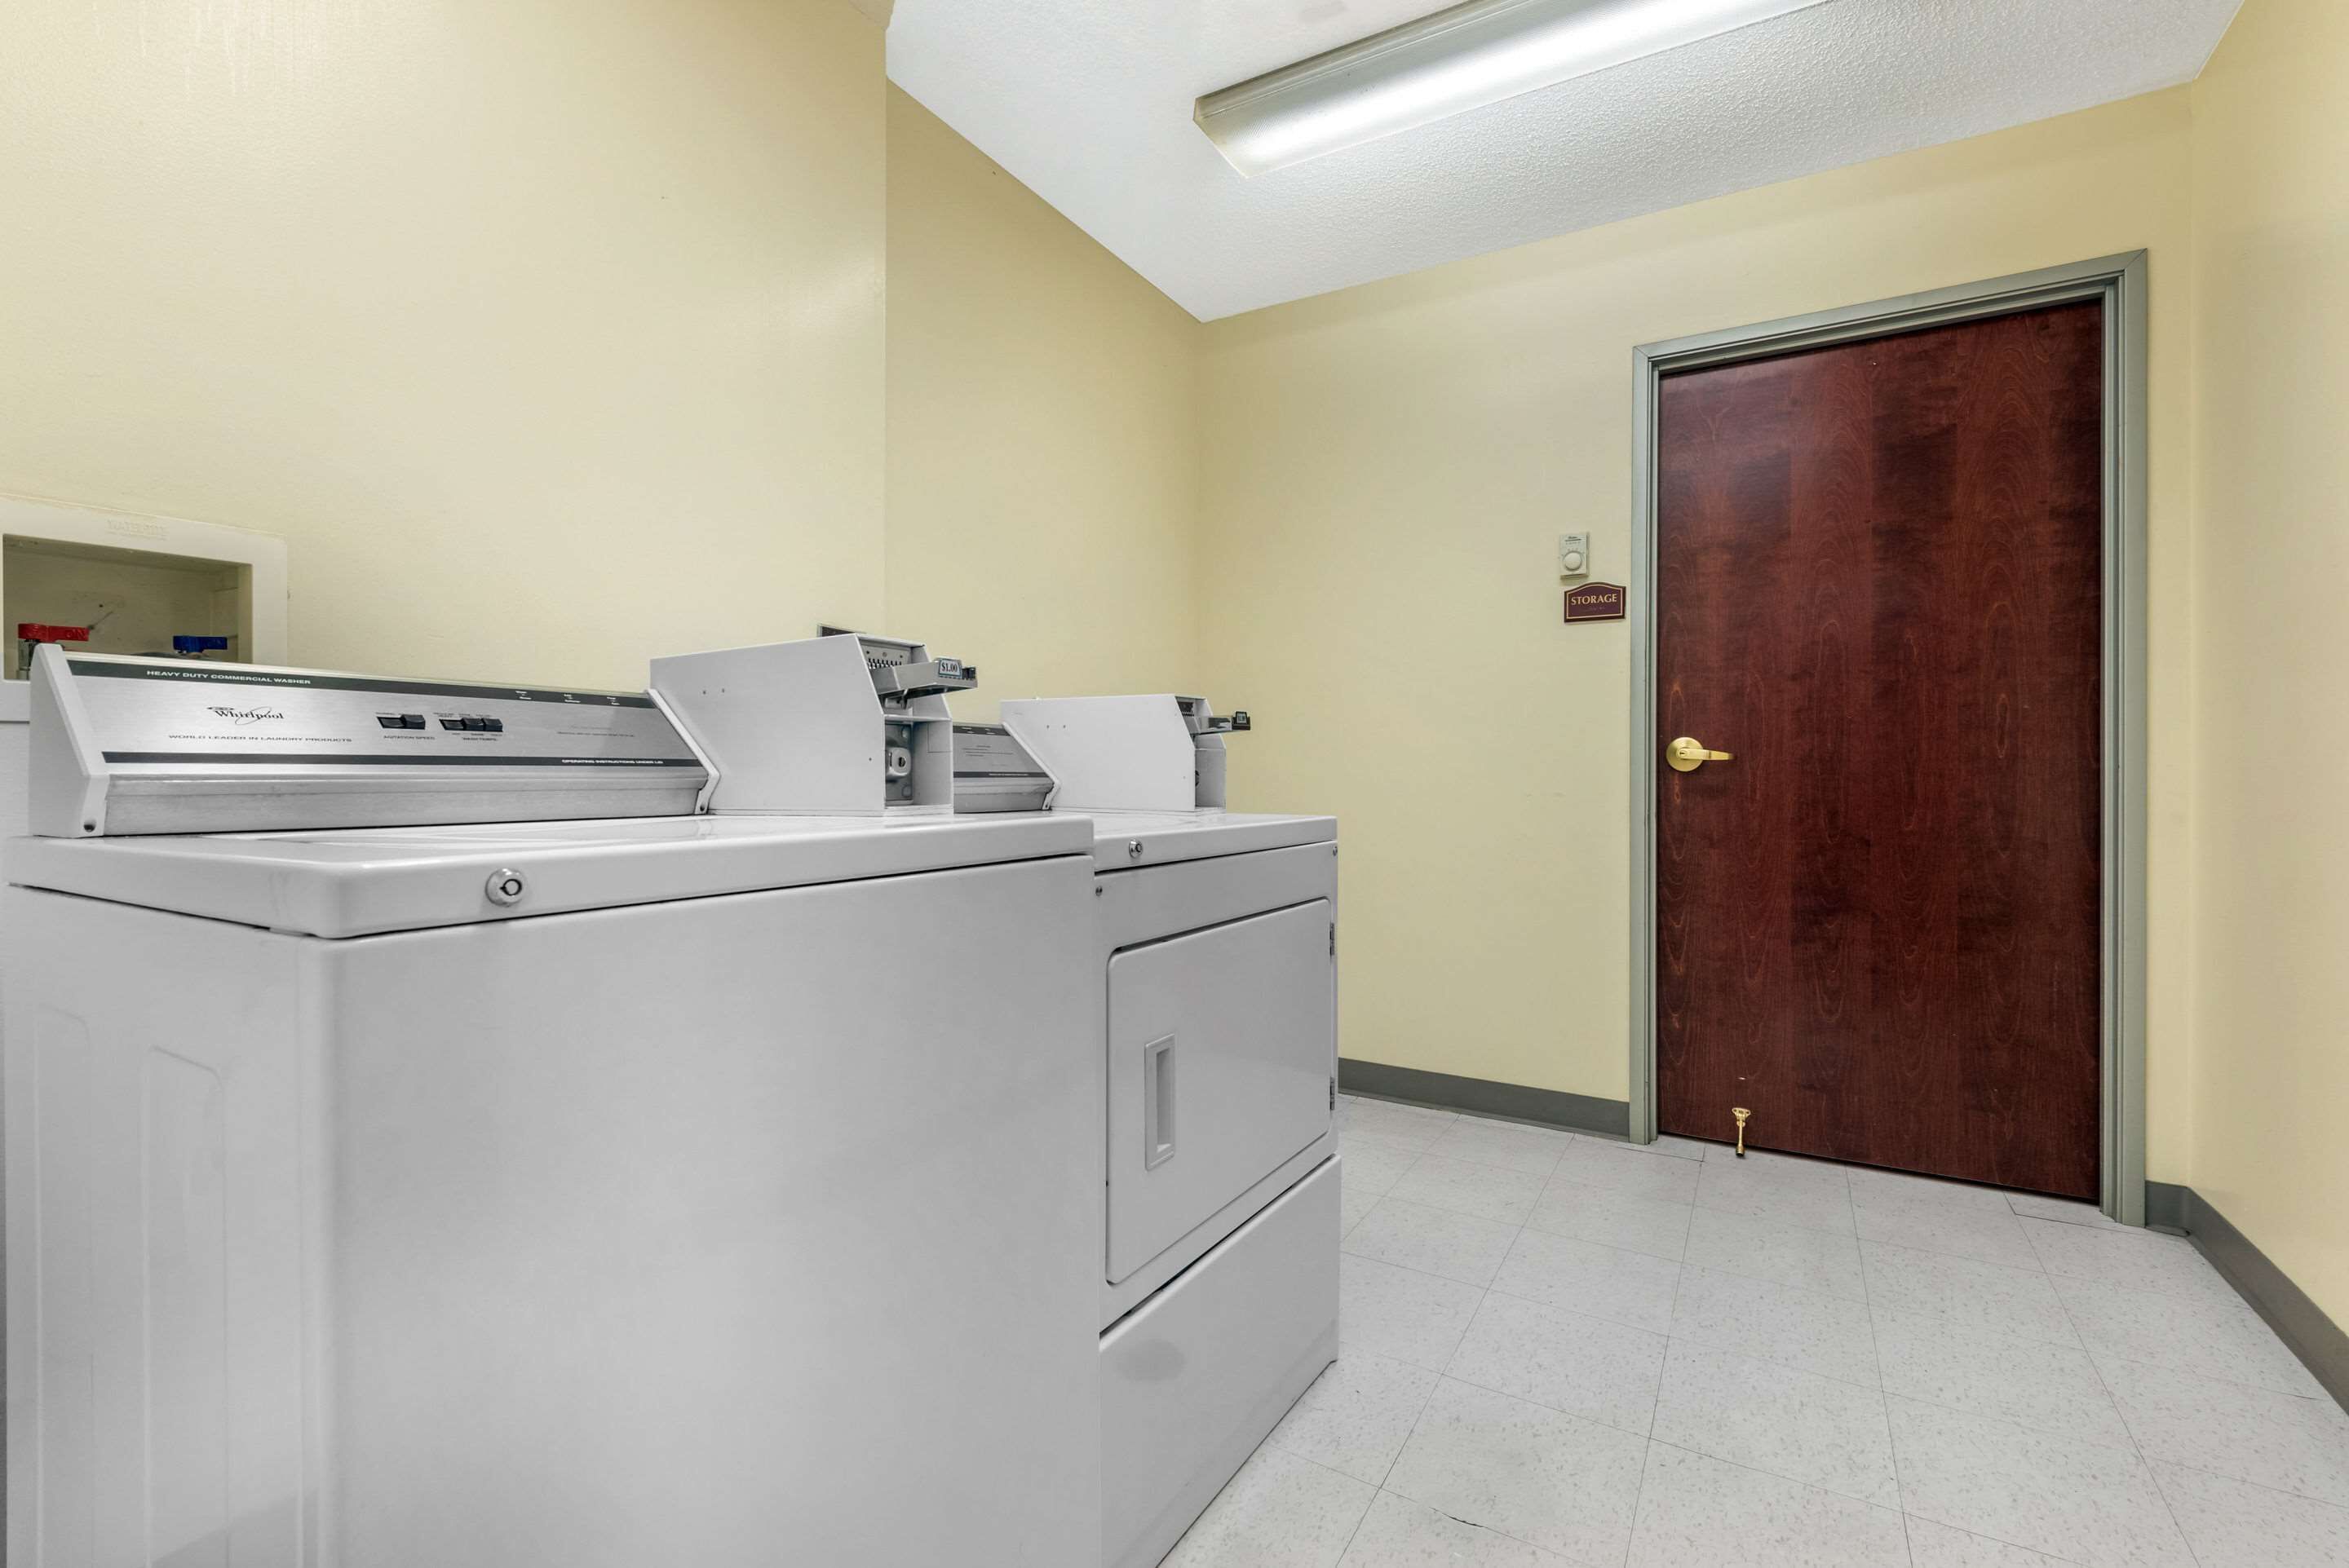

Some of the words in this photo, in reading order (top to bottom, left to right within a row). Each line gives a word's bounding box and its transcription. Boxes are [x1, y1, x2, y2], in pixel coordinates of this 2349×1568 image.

[1571, 594, 1617, 605] STORAGE
[941, 662, 958, 673] $1.00
[210, 674, 272, 682] COMMERCIAL
[214, 709, 285, 722] Whirlpool
